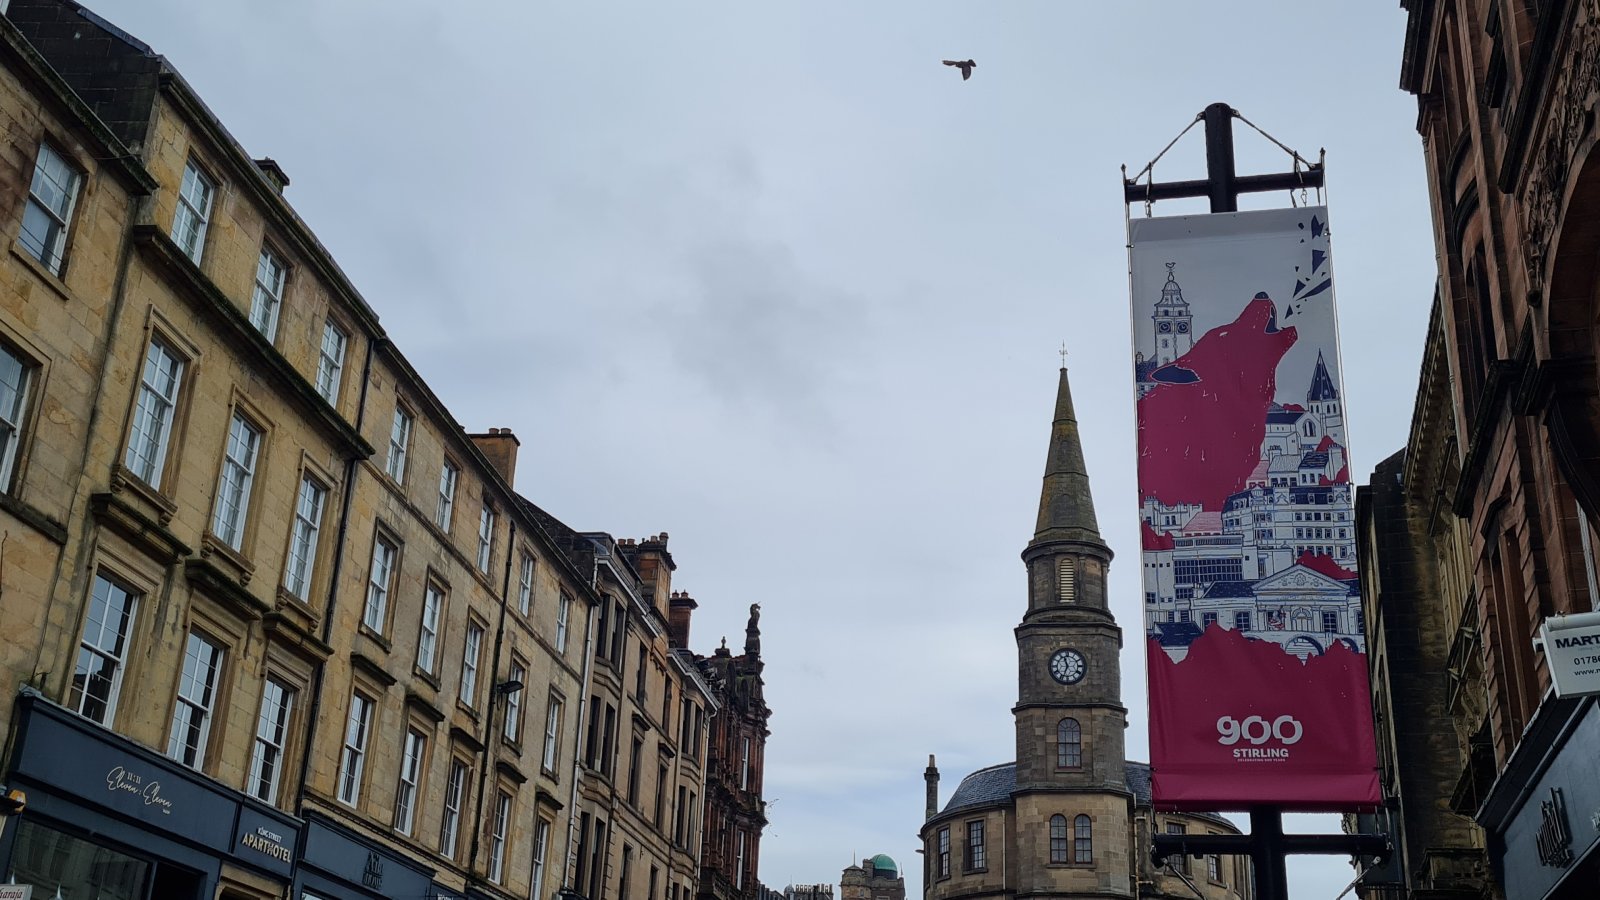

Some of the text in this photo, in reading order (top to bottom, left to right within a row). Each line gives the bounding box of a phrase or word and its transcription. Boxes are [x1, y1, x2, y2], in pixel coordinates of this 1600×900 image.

[1555, 635, 1600, 648] MART
[1216, 714, 1303, 745] 900
[1233, 748, 1289, 758] STIRLING
[242, 832, 291, 863] APARTHOTEL
